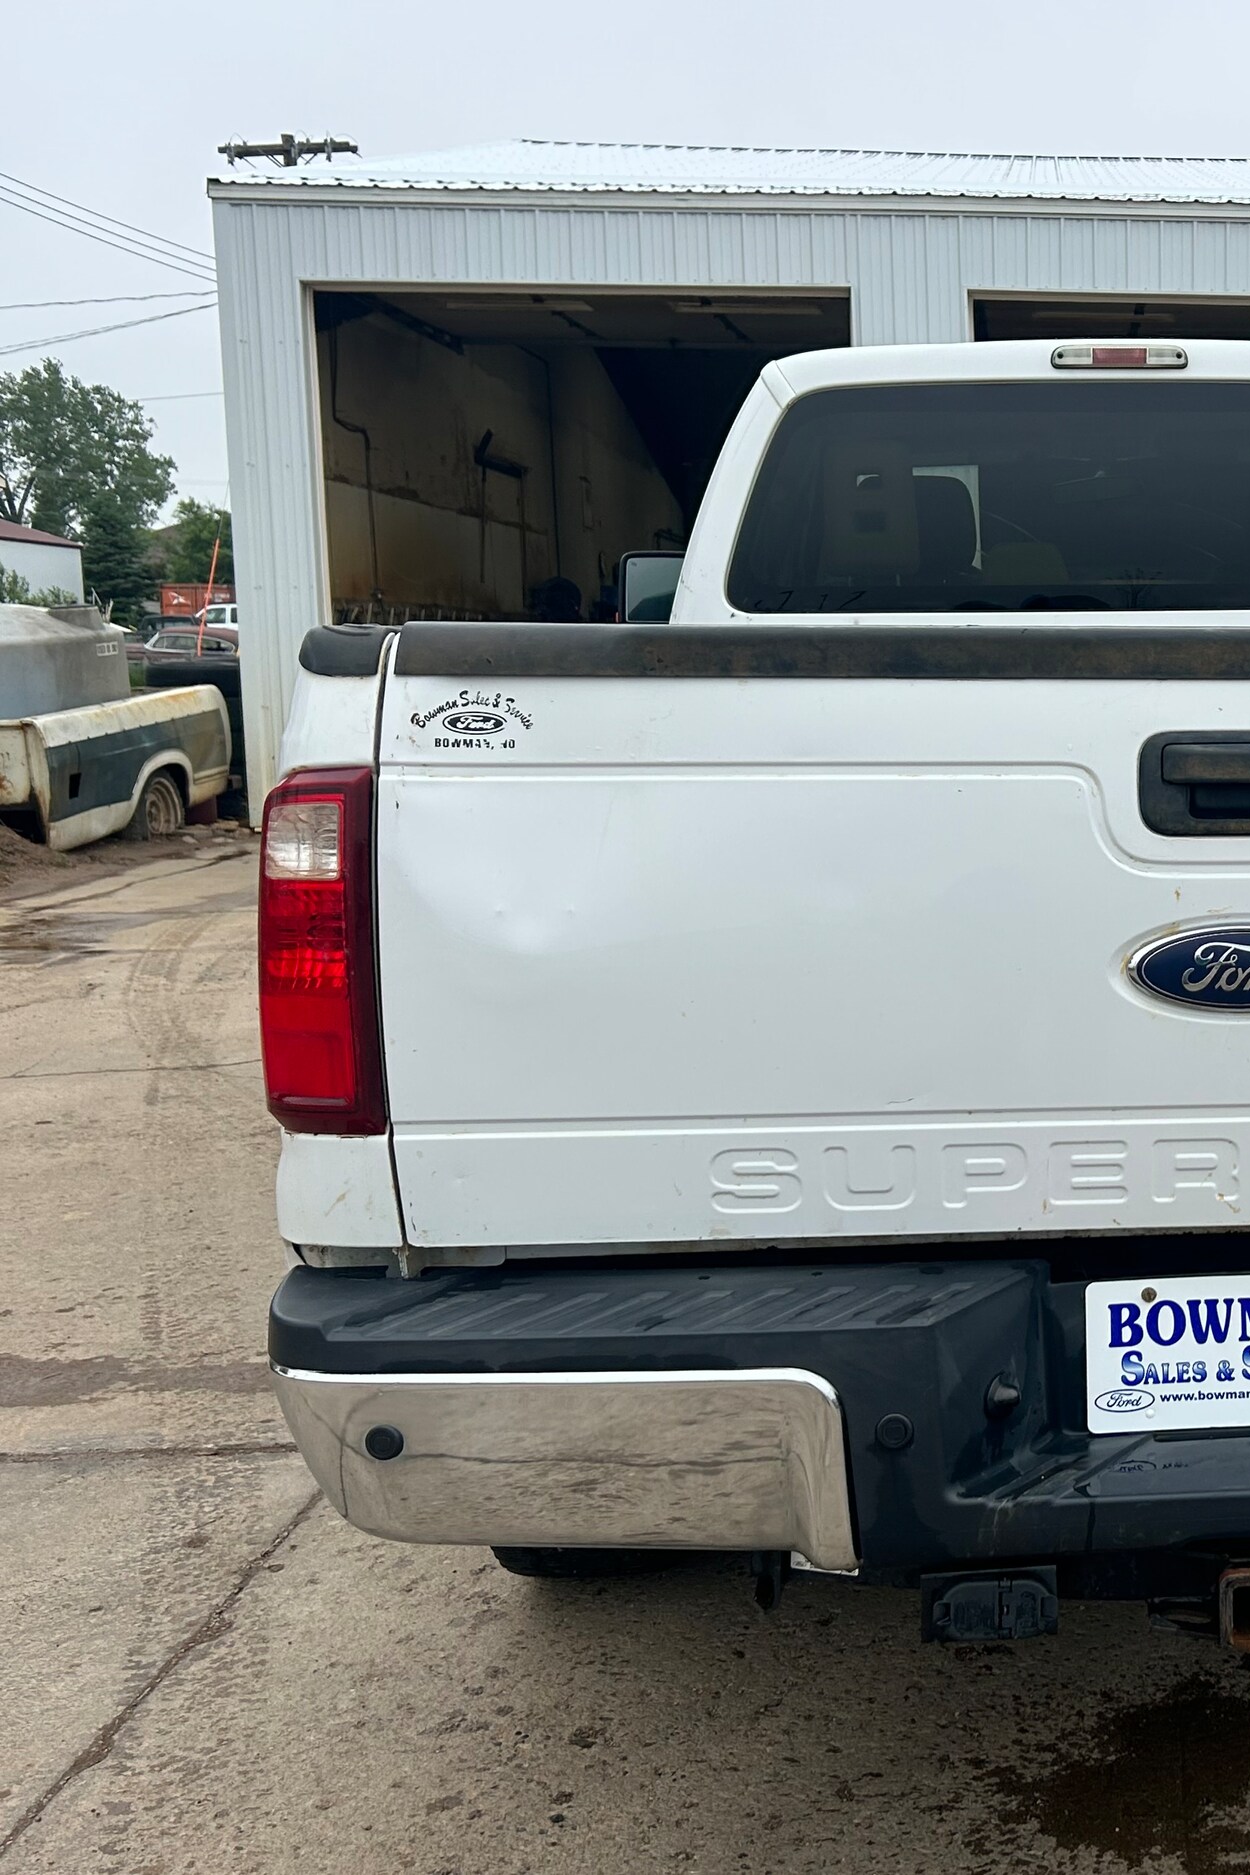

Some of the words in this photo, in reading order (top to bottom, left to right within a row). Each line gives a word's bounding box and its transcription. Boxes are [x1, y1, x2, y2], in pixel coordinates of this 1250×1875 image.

[456, 715, 497, 729] Ford
[709, 1138, 1241, 1214] SUPER
[1216, 1359, 1236, 1382] &
[1106, 1392, 1142, 1408] Ford
